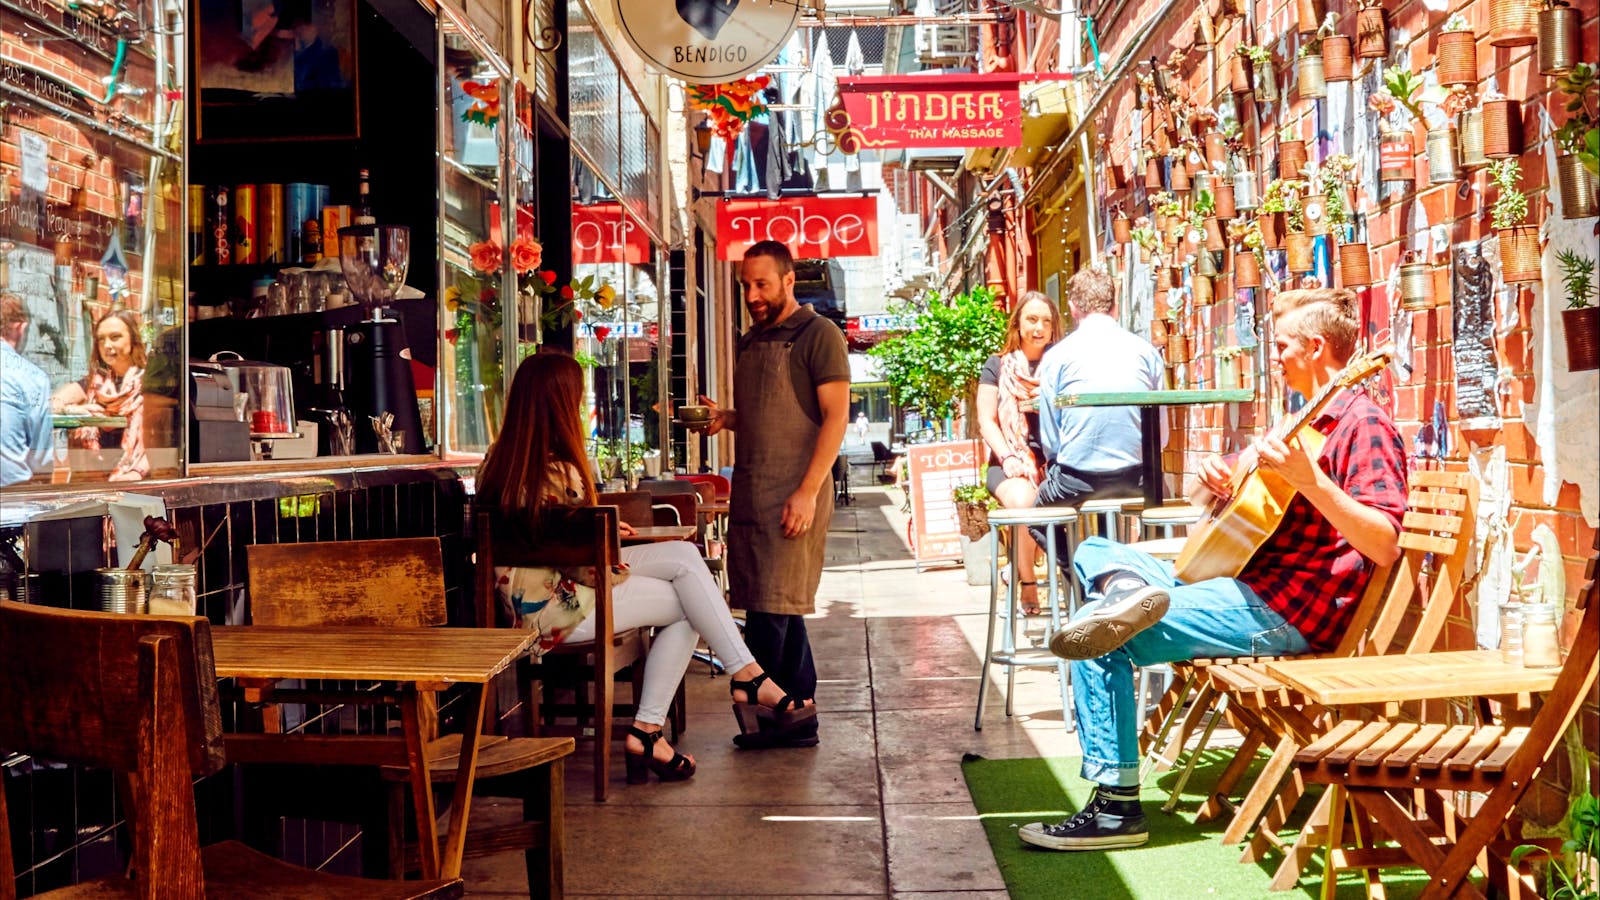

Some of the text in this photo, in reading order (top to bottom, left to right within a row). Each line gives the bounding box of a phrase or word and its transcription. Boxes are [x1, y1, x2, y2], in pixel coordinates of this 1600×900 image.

[674, 44, 748, 64] BENDIGO
[908, 127, 1004, 139] THAI MASSAGE
[731, 206, 865, 246] robe
[920, 448, 975, 469] robe
